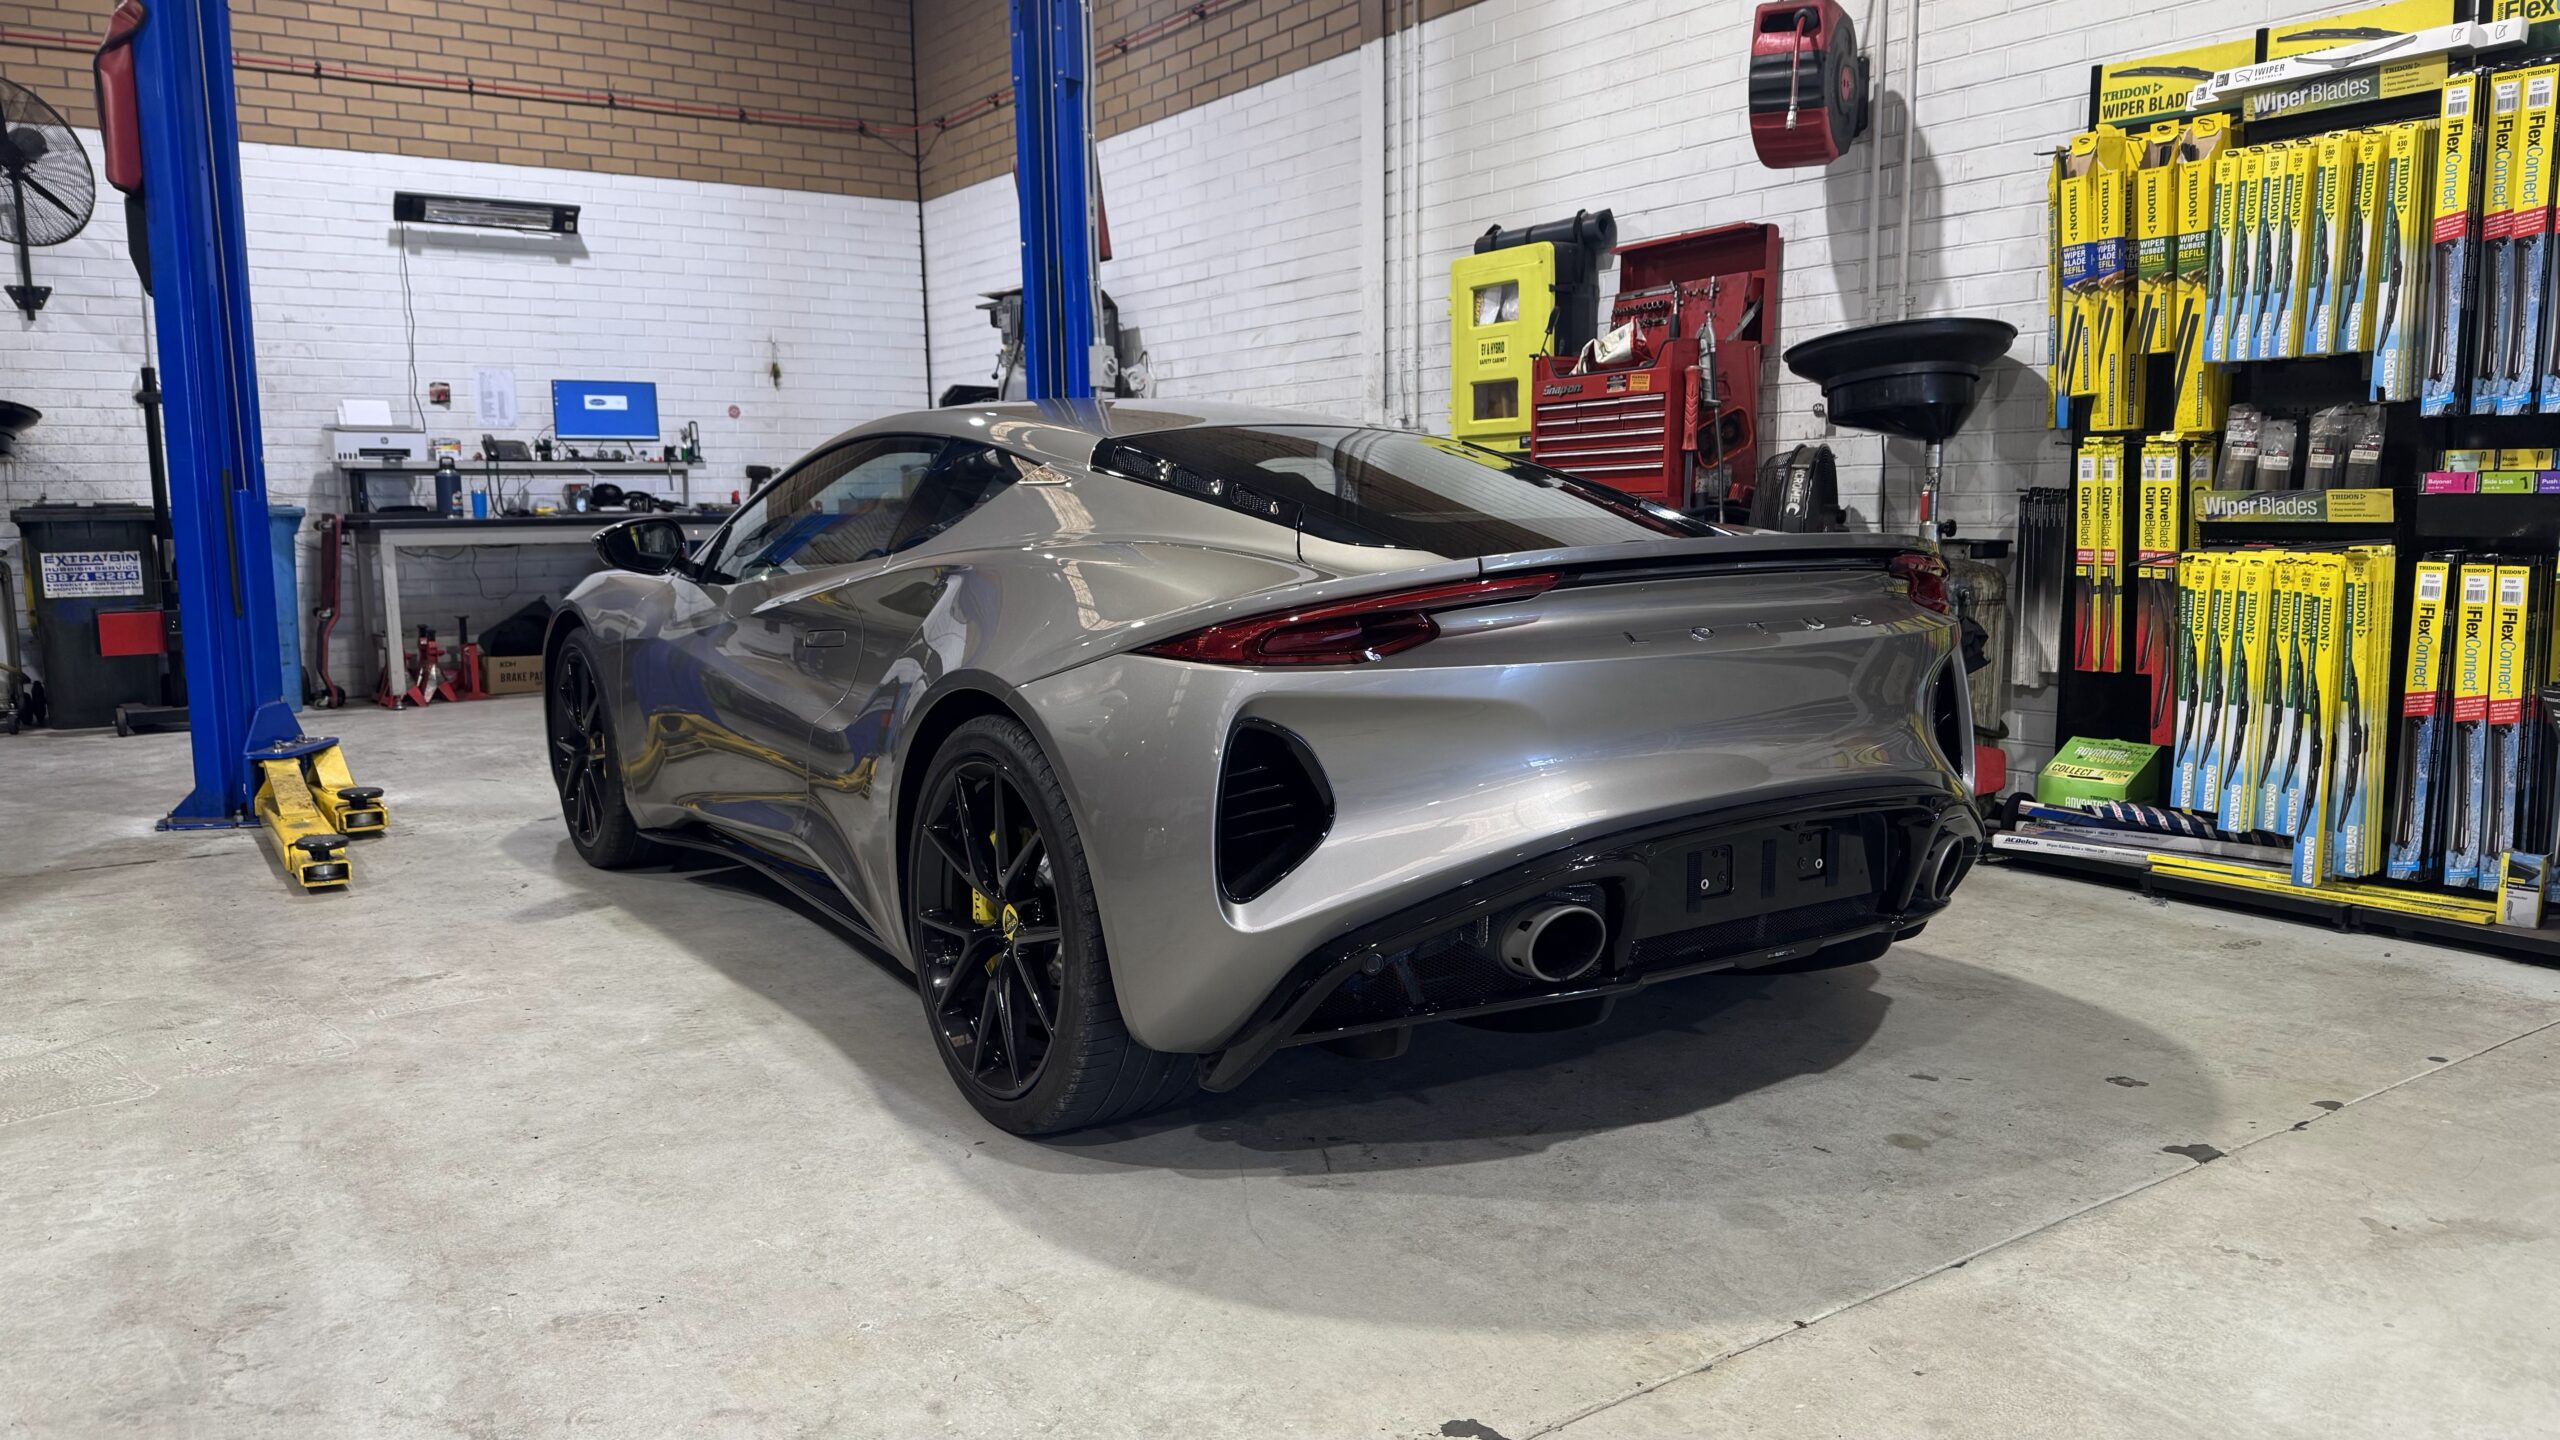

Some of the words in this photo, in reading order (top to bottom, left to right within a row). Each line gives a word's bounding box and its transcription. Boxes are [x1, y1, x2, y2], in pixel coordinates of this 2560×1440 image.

[2255, 64, 2285, 77] IWIPER
[2384, 64, 2414, 73] TRIDON
[2446, 78, 2468, 86] TRIDON
[2494, 74, 2518, 82] TRIDON
[2526, 68, 2550, 76] TRIDON
[2102, 84, 2151, 102] TRIDON
[2102, 99, 2144, 120] WIPER
[2253, 88, 2310, 114] Wiper
[2310, 78, 2370, 104] Blades
[2270, 160, 2280, 168] 330
[2442, 123, 2464, 210] FlexConnect
[2492, 119, 2514, 208] FlexConnect
[2522, 115, 2546, 205] FlexConnect
[2188, 171, 2198, 218] TRIDON
[2292, 172, 2304, 217] TRIDON
[2326, 165, 2337, 210] TRIDON
[2362, 161, 2375, 206] TRIDON
[2398, 156, 2410, 202] TRIDON
[2069, 186, 2078, 229] TRIDON
[2101, 179, 2109, 228] TRIDON
[2148, 177, 2156, 223] TRIDON
[2222, 182, 2232, 224] TRIDON
[2246, 178, 2258, 223] TRIDON
[2270, 176, 2281, 220] TRIDON
[2064, 249, 2086, 260] WIPER
[2140, 238, 2165, 248] WIPER
[2140, 246, 2166, 256] RUBBER
[2178, 240, 2206, 250] RUBBER
[2178, 248, 2206, 259] REFILL
[2179, 232, 2206, 244] WIPER
[2064, 256, 2086, 268] BLADE
[2064, 265, 2086, 276] REFILL
[2098, 252, 2116, 261] LADE
[2098, 260, 2116, 268] EFILL
[2140, 254, 2166, 264] REFILL
[1481, 343, 1486, 356] EV
[1490, 341, 1504, 354] HYBRID
[1492, 356, 1507, 364] CABINET
[2428, 478, 2452, 486] Bayonet
[2080, 486, 2092, 547] CurveBlade
[2100, 486, 2112, 547] CurveBlade
[2144, 486, 2156, 548] CurveBlade
[2160, 486, 2172, 549] CurveBlade
[2203, 496, 2260, 518] Wiper
[2260, 496, 2318, 516] Blades
[44, 554, 104, 566] EXTRA
[109, 553, 138, 562] BIN
[48, 573, 89, 582] 9874
[96, 571, 138, 580] 5284
[2194, 590, 2206, 632] TRIDON
[2220, 590, 2232, 632] TRIDON
[2246, 592, 2258, 634] TRIDON
[2280, 590, 2292, 633] TRIDON
[2302, 592, 2312, 640] TRIDON
[2320, 597, 2332, 640] TRIDON
[2356, 582, 2366, 627] TRIDON
[1623, 613, 1872, 646] LOTUS
[2413, 606, 2435, 688] FlexConnect
[2462, 610, 2482, 692] FlexConnect
[2498, 612, 2518, 694] FlexConnect
[500, 672, 528, 683] BRAKE
[2074, 746, 2130, 760] ADVANTAGE
[2052, 764, 2094, 776] COLLECT
[2004, 836, 2039, 846] ACDelco
